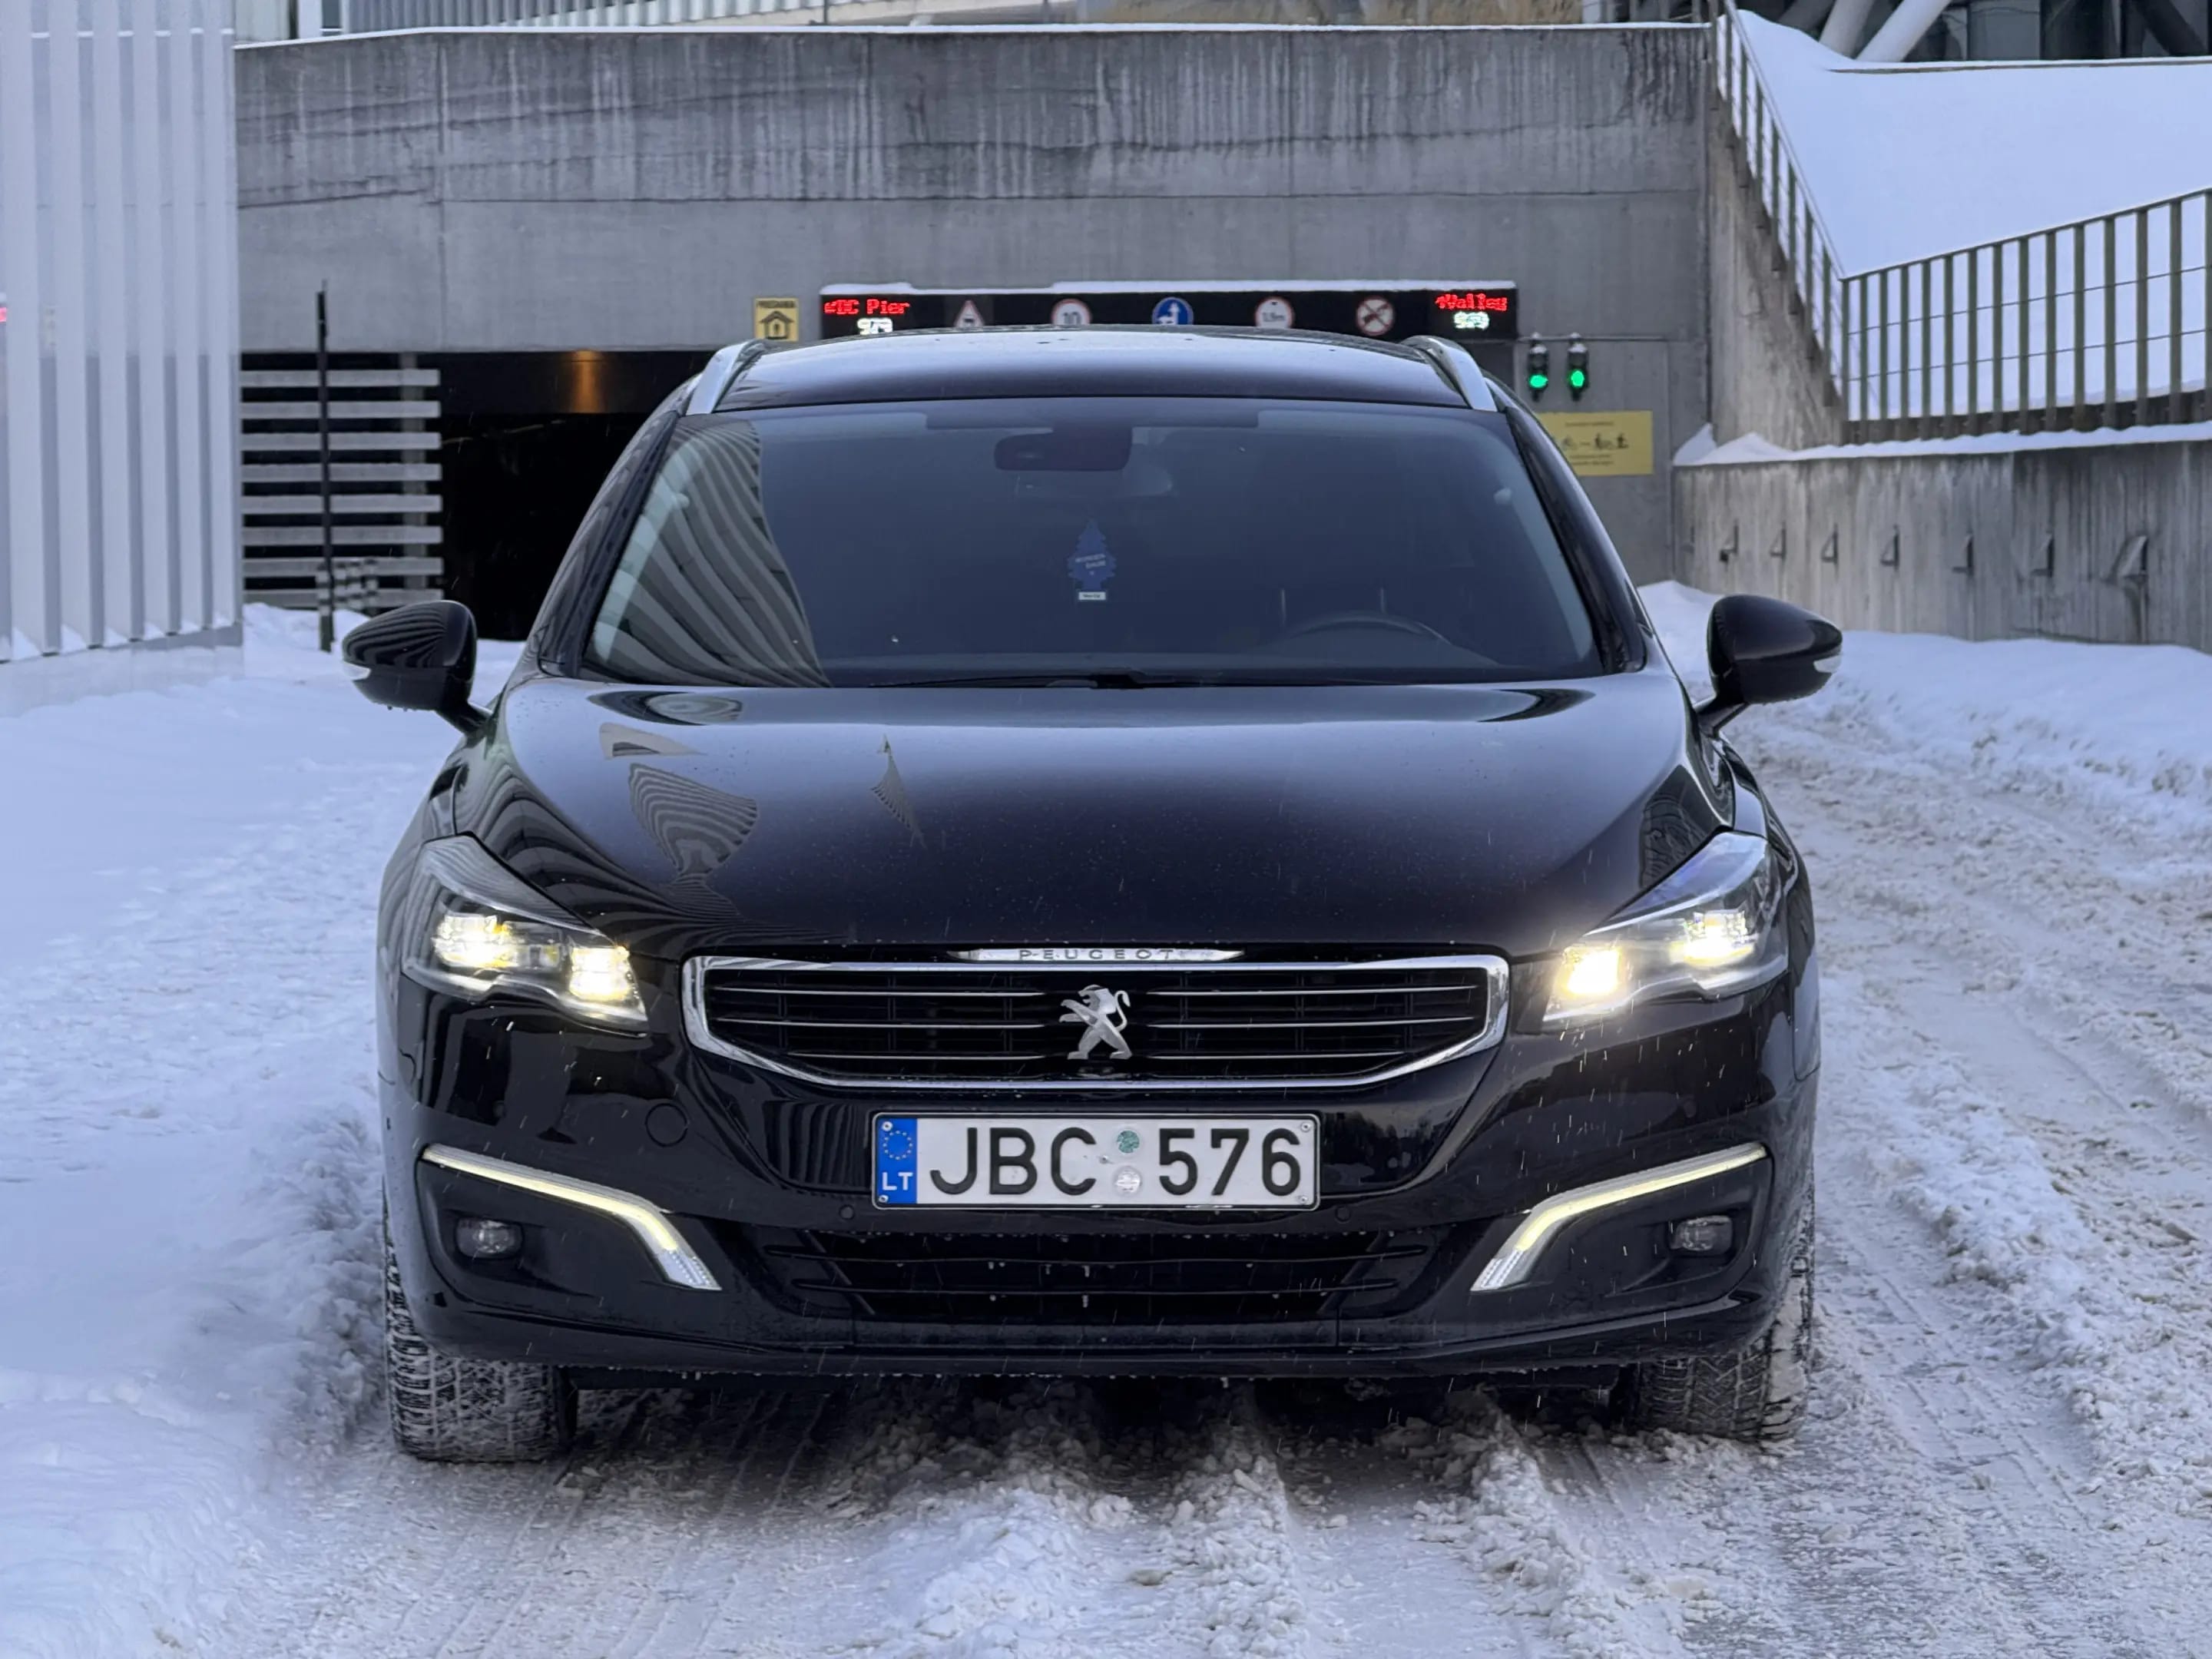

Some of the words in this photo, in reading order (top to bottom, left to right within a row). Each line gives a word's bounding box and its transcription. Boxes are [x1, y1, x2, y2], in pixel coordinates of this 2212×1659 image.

[866, 299, 910, 314] Pier
[1019, 949, 1174, 960] PEUGEOT
[929, 1126, 1097, 1196] JBC
[1158, 1128, 1301, 1196] 576
[881, 1171, 913, 1191] LT
